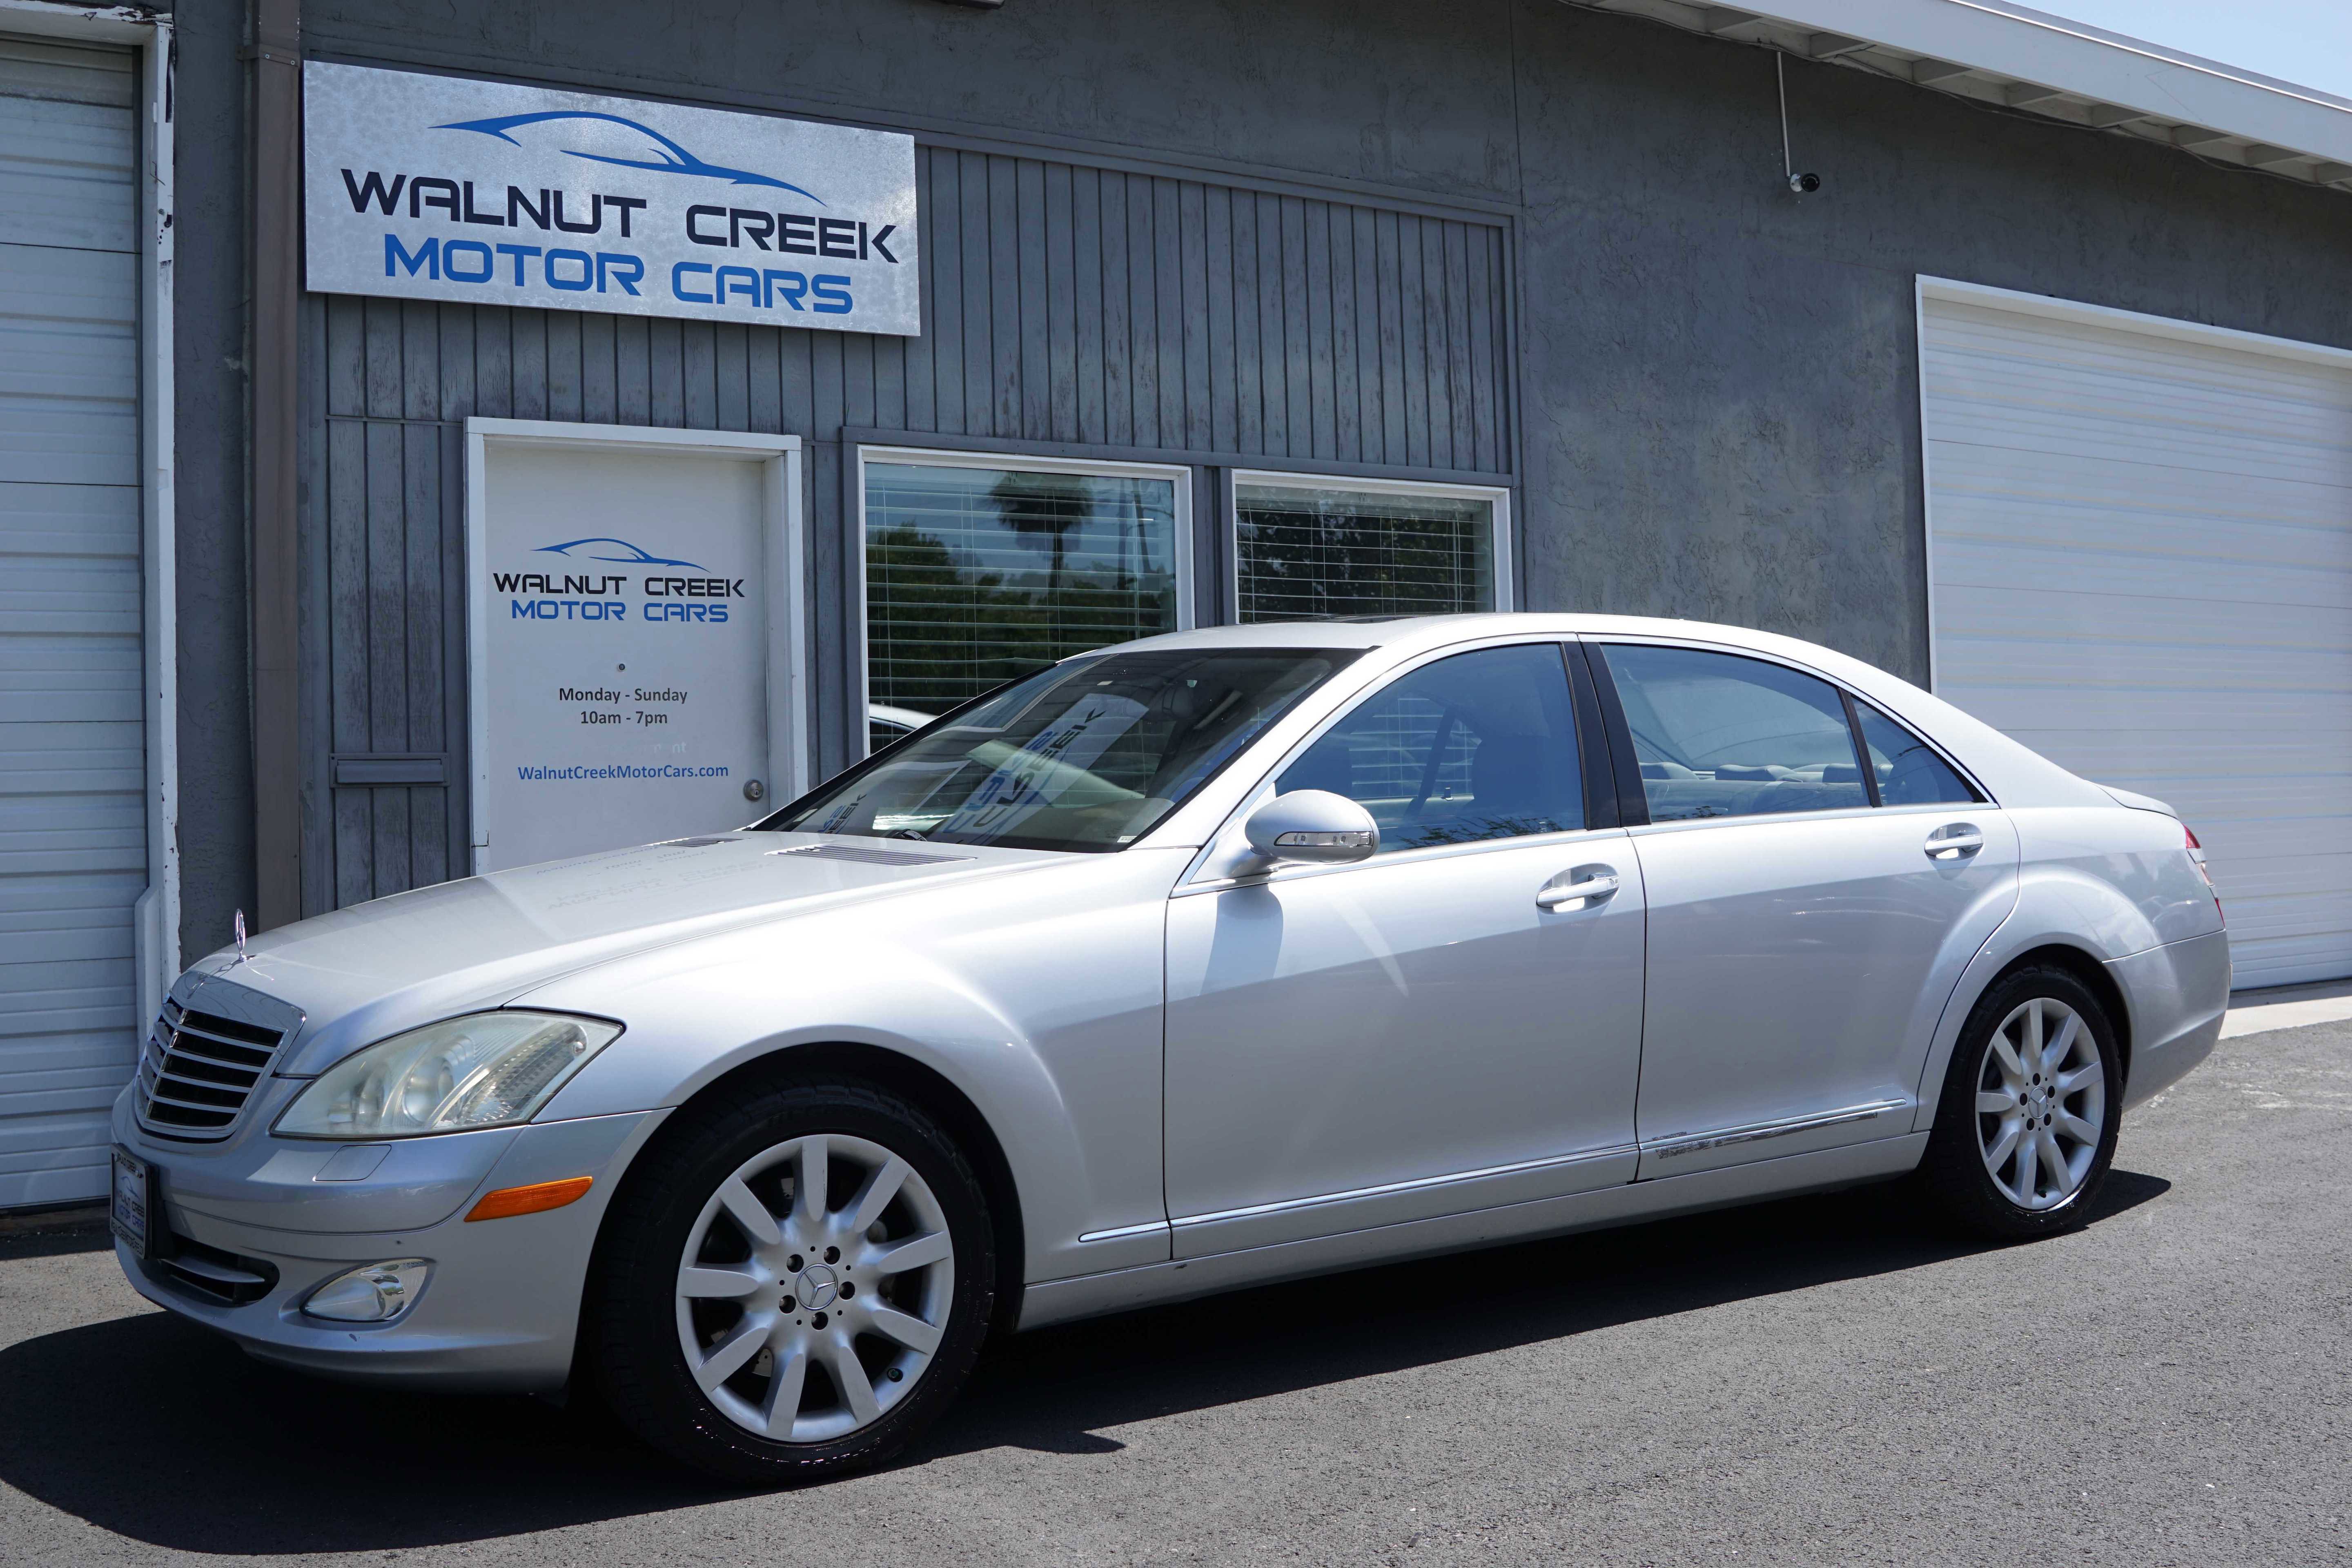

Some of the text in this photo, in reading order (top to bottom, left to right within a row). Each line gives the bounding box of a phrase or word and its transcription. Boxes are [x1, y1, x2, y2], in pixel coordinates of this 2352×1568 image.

[341, 168, 898, 263] WALNUT CREEK
[385, 234, 853, 314] MOTOR CARS
[493, 573, 745, 597] WALNUT CREEK
[512, 599, 728, 623] MOTOR CARS
[560, 688, 621, 704] Monday
[635, 688, 688, 704] Sunday
[581, 711, 621, 724] 10am
[636, 711, 668, 727] 7pm
[518, 765, 728, 780] WalnutCreekMotorCars.com
